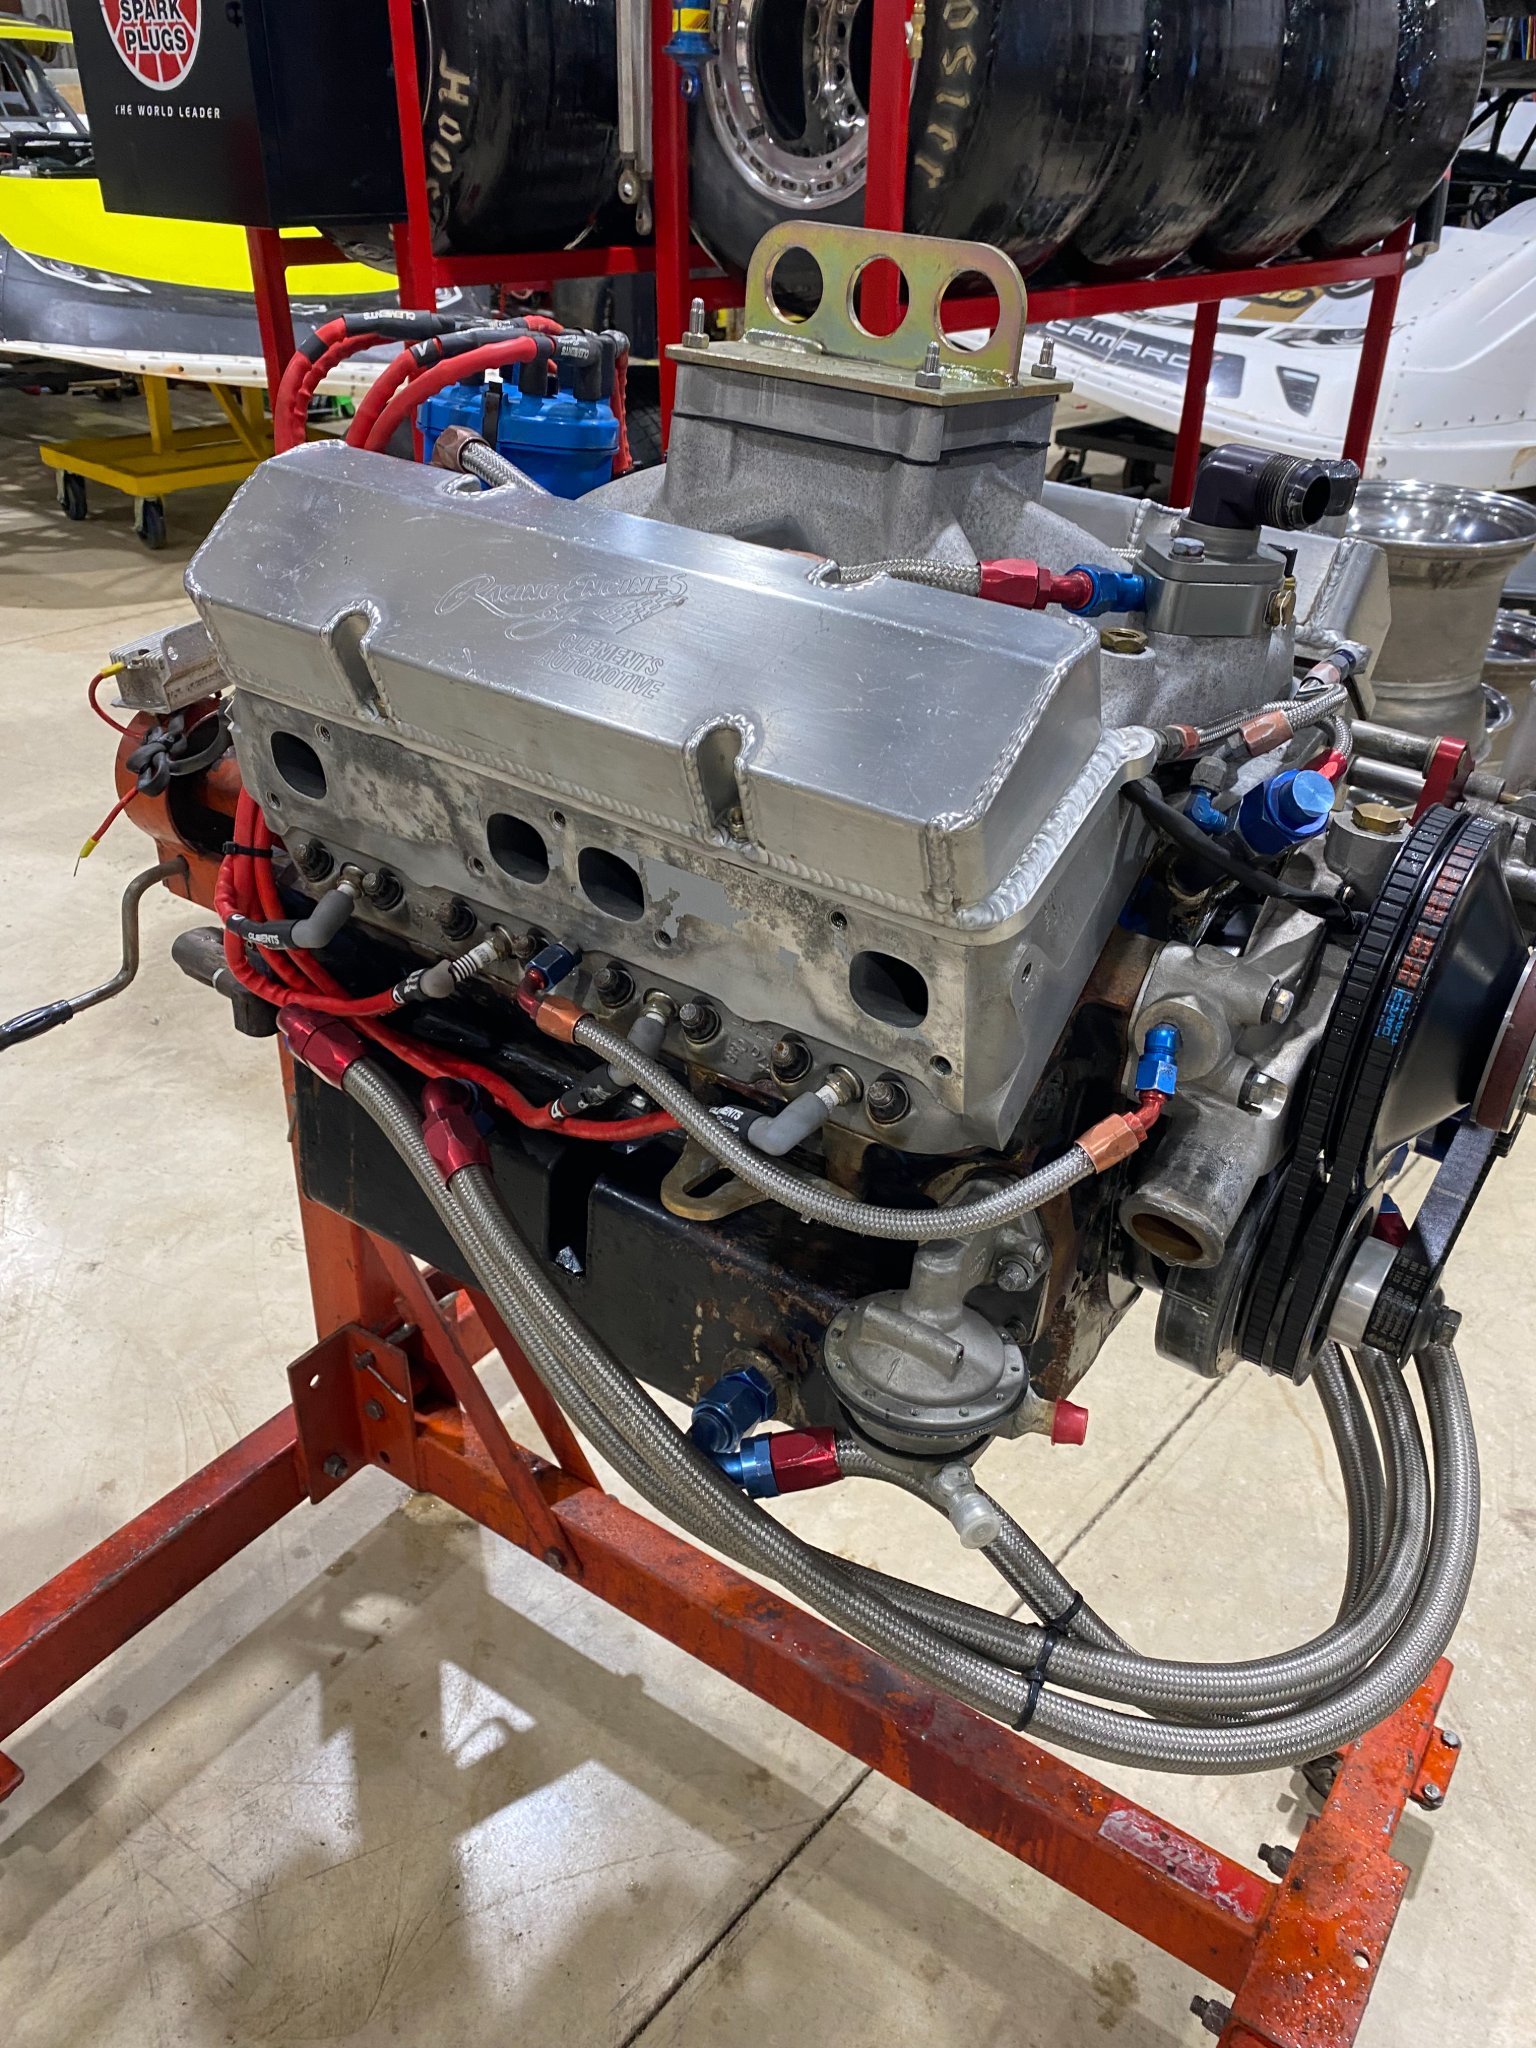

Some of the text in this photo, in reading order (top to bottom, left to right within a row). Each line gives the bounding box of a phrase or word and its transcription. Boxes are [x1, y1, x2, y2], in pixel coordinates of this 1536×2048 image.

[120, 0, 182, 20] SPARK
[124, 27, 187, 52] PLUGS
[115, 104, 220, 119] THE WORLD LEADER
[558, 633, 664, 676] CLEMENTS
[536, 649, 665, 700] AUTOMOTIVE
